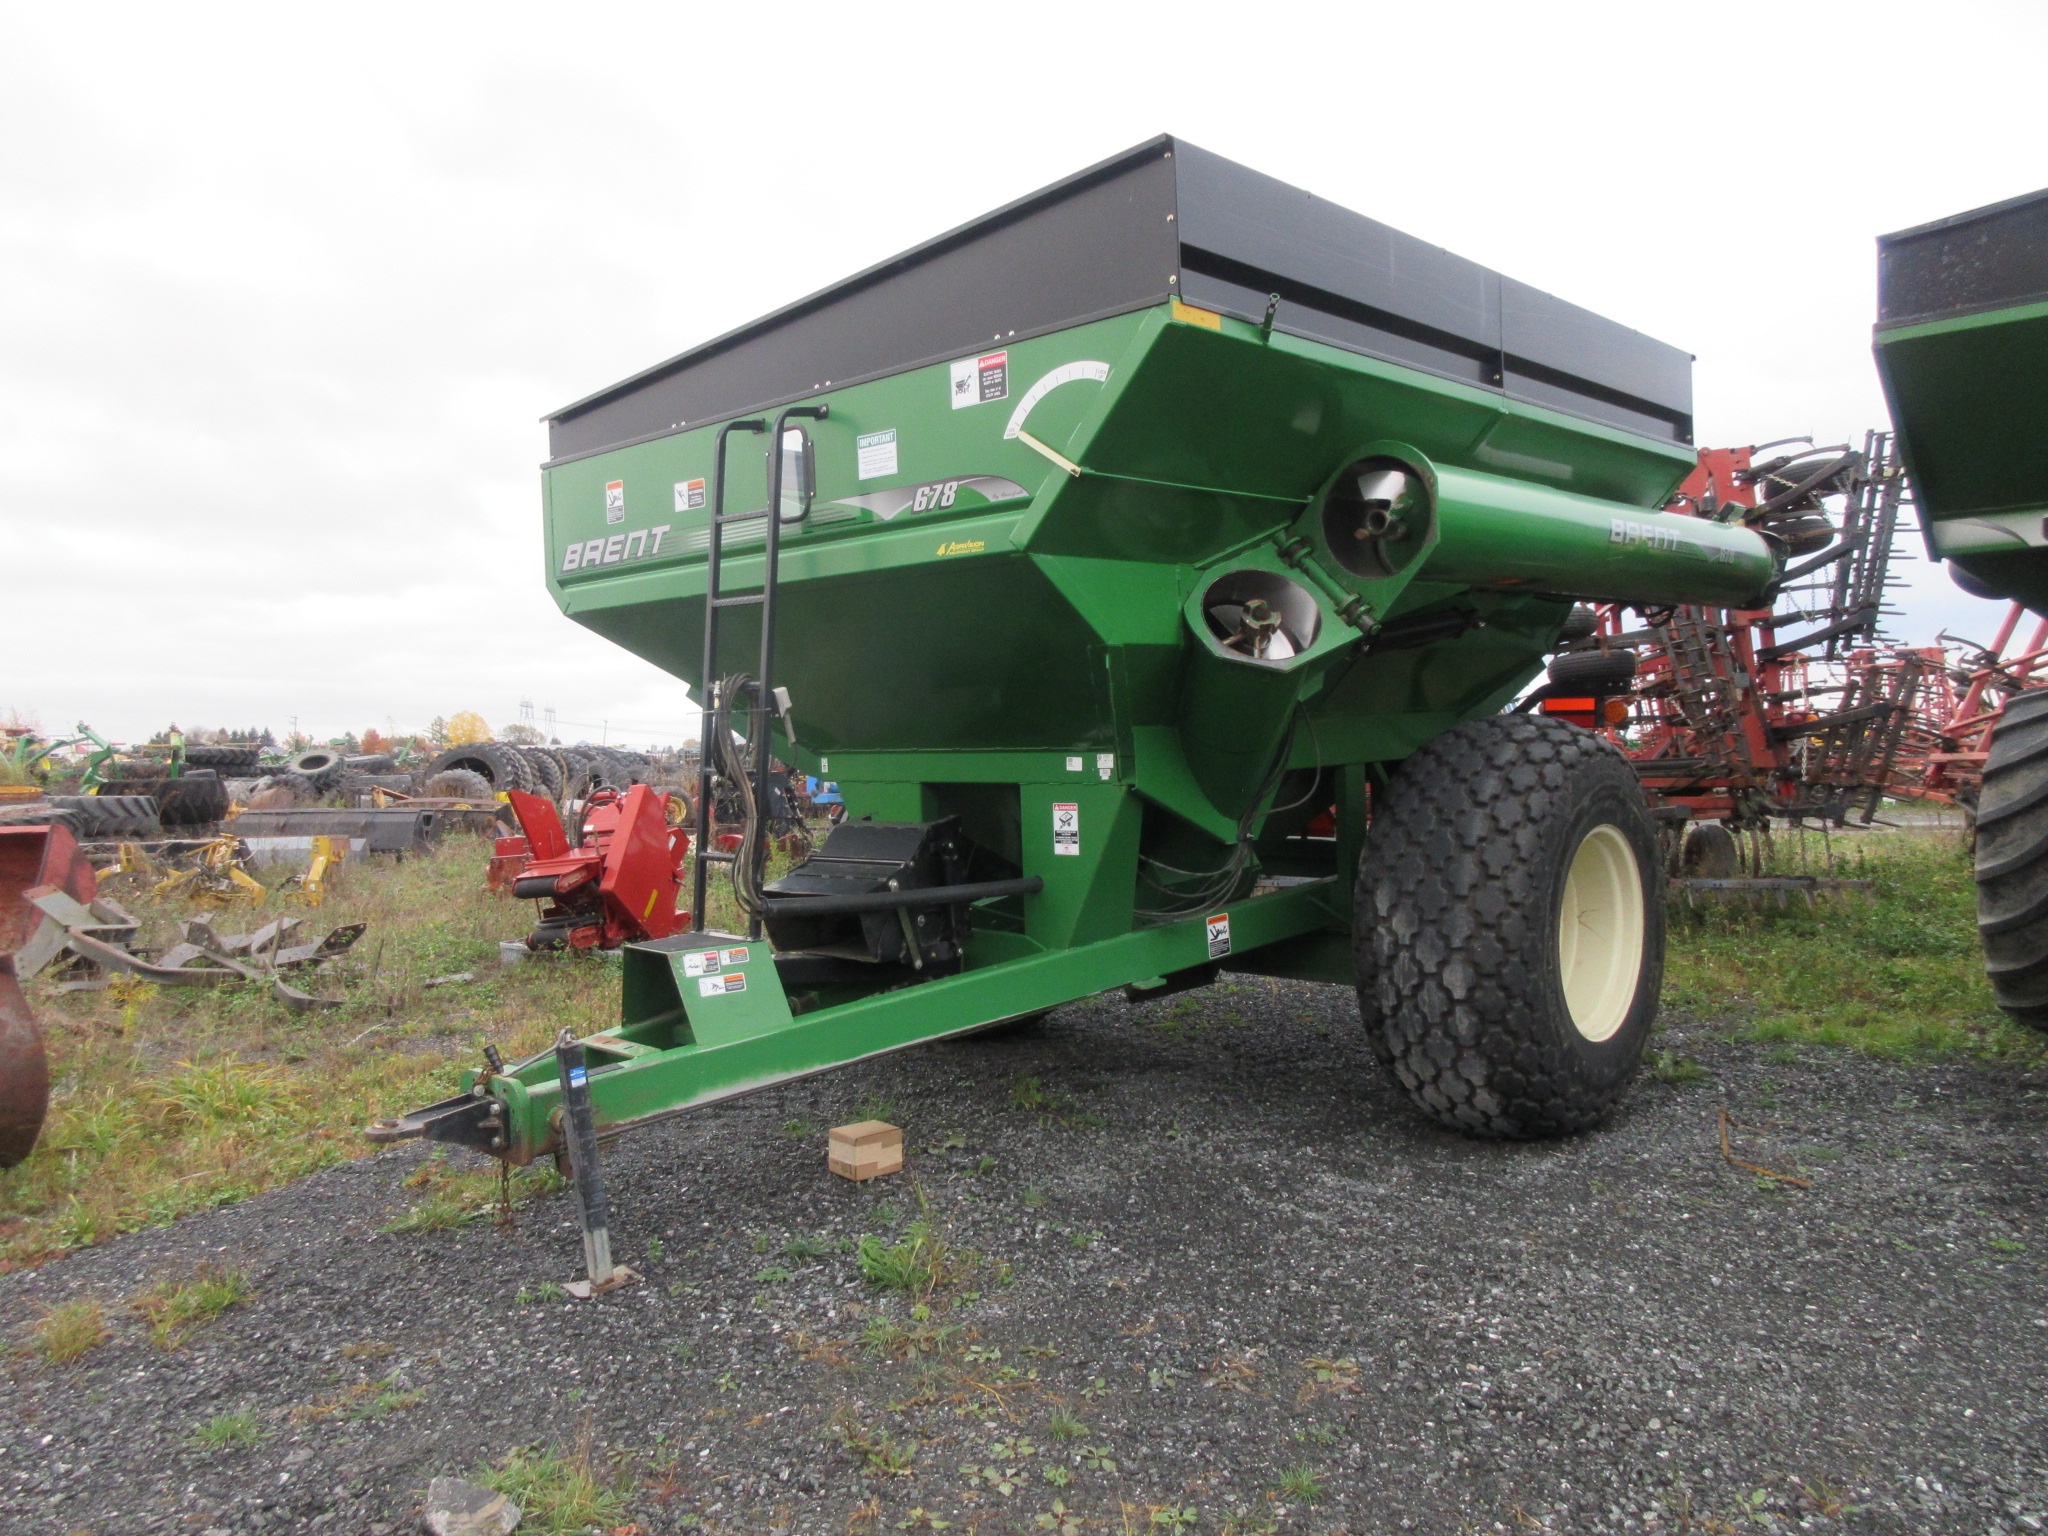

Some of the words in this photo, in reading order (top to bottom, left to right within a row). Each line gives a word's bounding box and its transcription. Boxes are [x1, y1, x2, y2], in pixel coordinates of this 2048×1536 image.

[984, 355, 1006, 366] DANGER
[859, 432, 894, 448] IMPORTANT
[912, 481, 959, 513] 678
[561, 524, 672, 572] BRENT
[1610, 518, 1680, 551] BRENT
